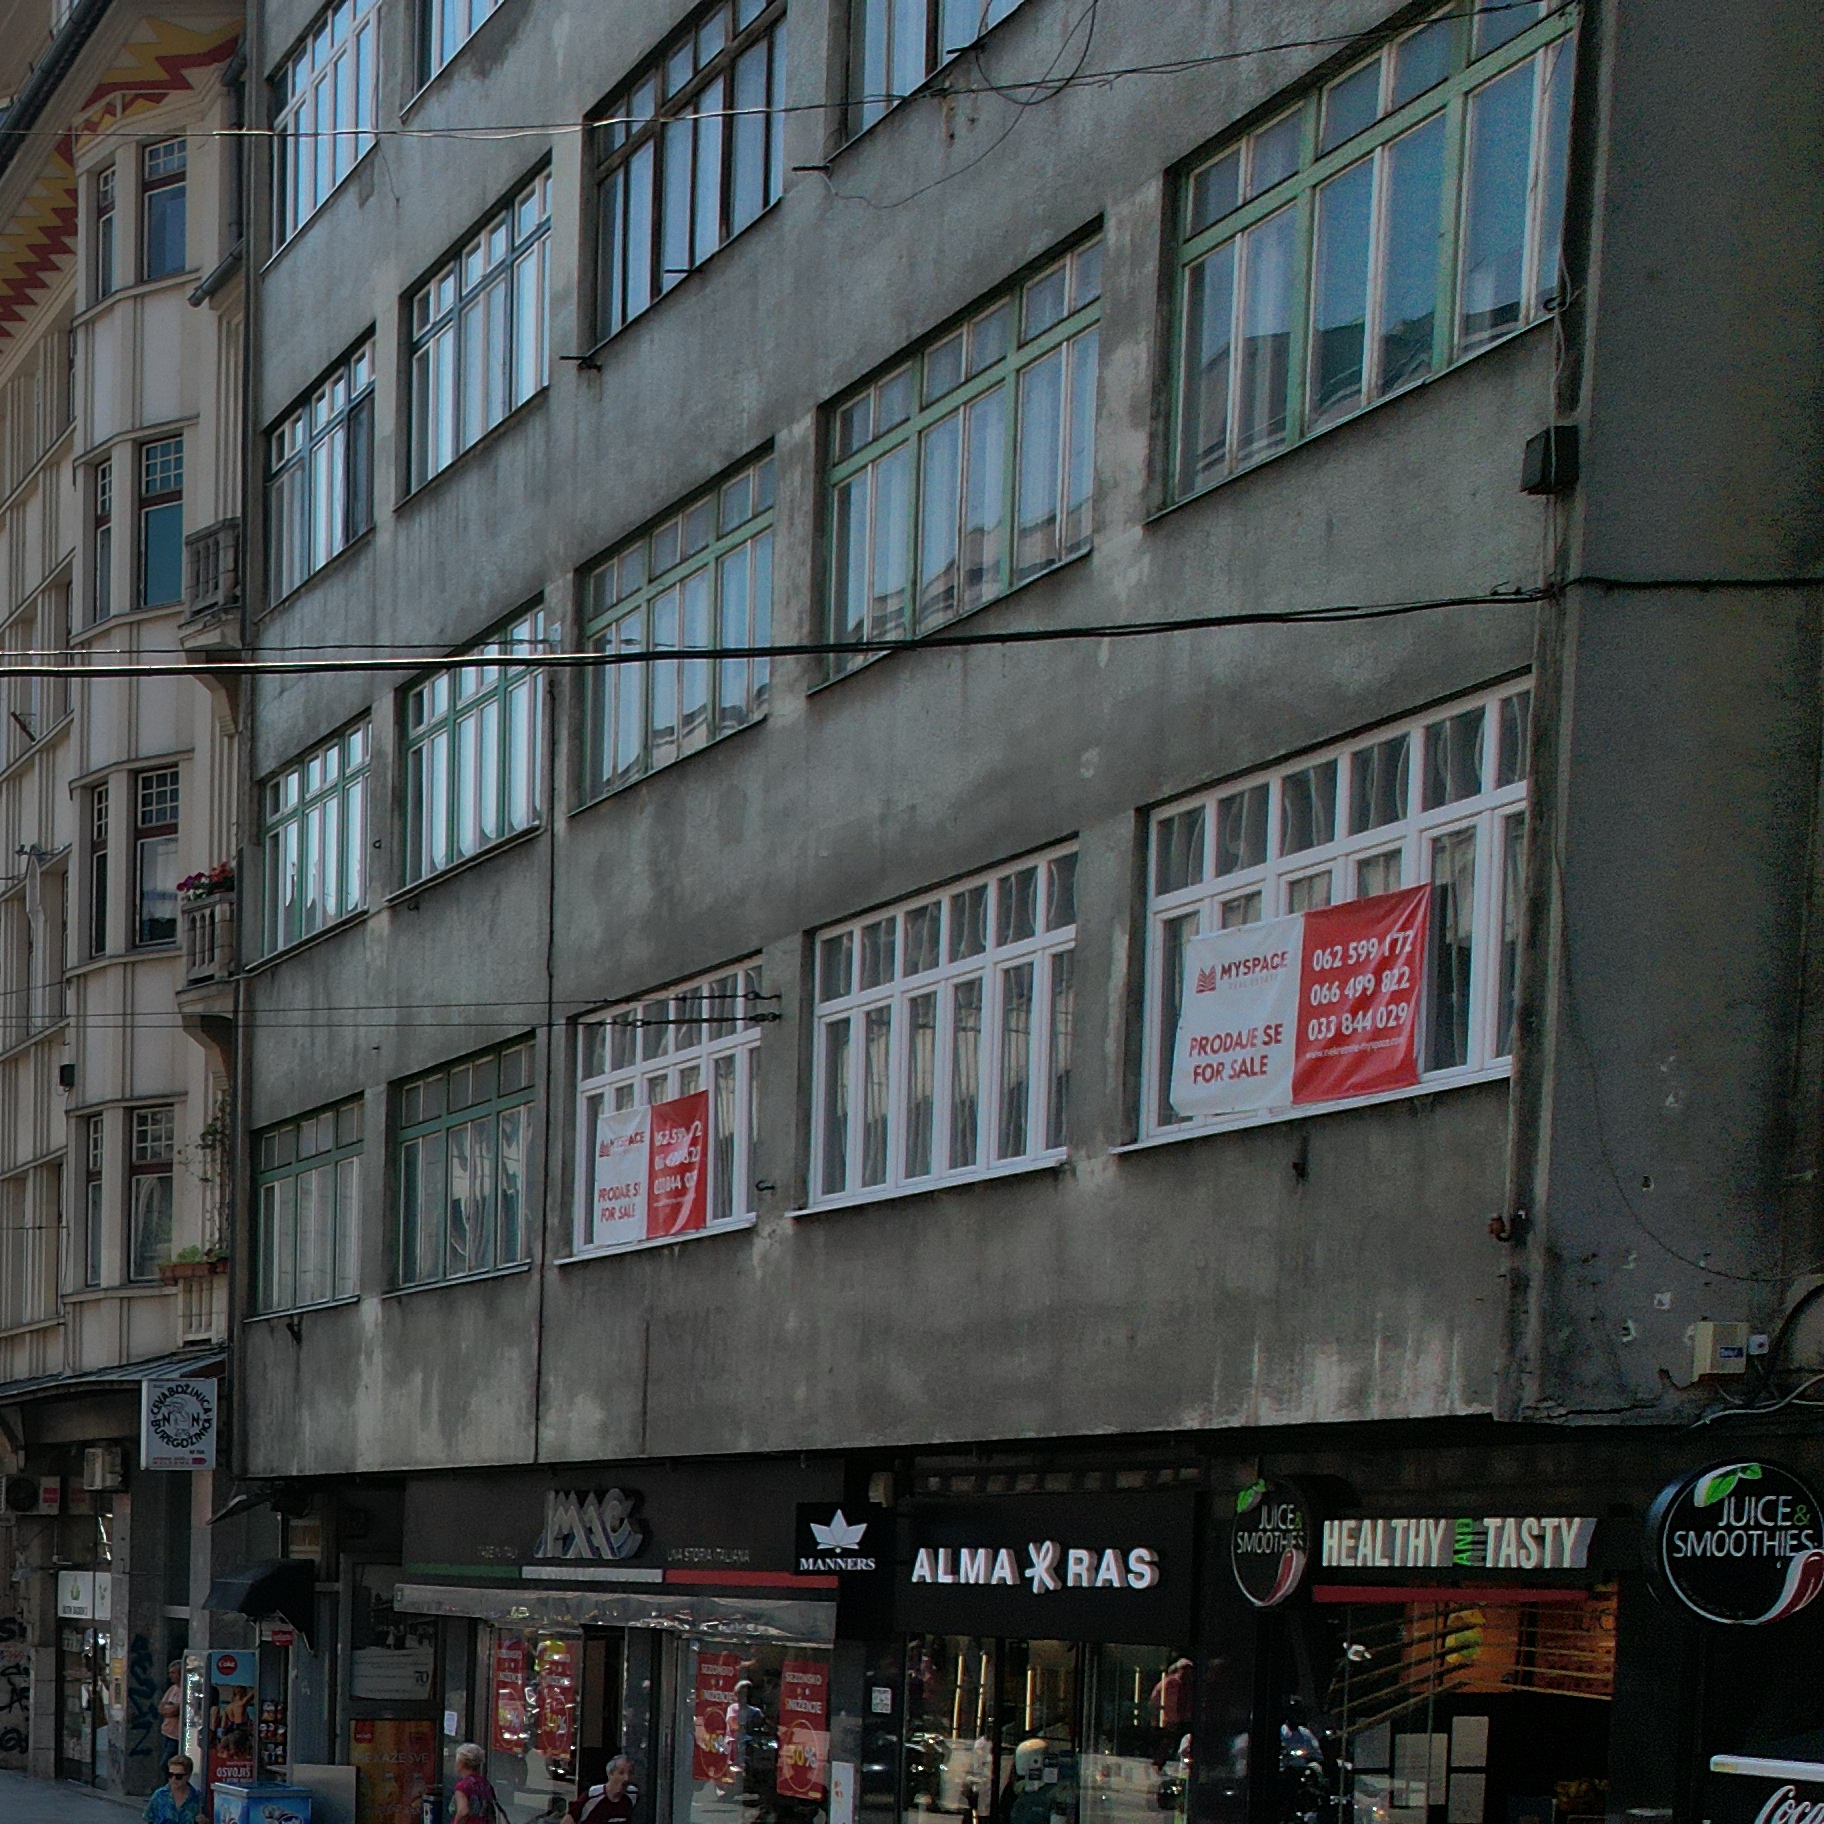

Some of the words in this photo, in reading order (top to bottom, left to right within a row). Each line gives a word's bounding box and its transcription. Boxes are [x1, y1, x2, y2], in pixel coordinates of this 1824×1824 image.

[1220, 951, 1289, 980] MYSPACE
[1313, 945, 1342, 971] 062
[1348, 937, 1378, 965] 599
[1310, 981, 1340, 1006] 066
[1344, 974, 1375, 999] 499
[1382, 966, 1411, 993] 822
[1308, 1014, 1336, 1041] 033
[1341, 1008, 1373, 1036] 844
[1376, 1002, 1408, 1029] 029
[1189, 1027, 1258, 1058] PRODAJE
[1263, 1023, 1283, 1045] SE
[1193, 1061, 1225, 1085] FOR
[1228, 1055, 1269, 1080] SALE
[1321, 1519, 1449, 1568] HEALTHY
[1453, 1517, 1474, 1566] AND
[1482, 1517, 1584, 1569] TASTY
[1672, 1529, 1815, 1558] SMOOTHIES
[799, 1556, 877, 1572] MANNERS
[911, 1546, 1022, 1586] ALMA
[1066, 1546, 1161, 1591] RAS
